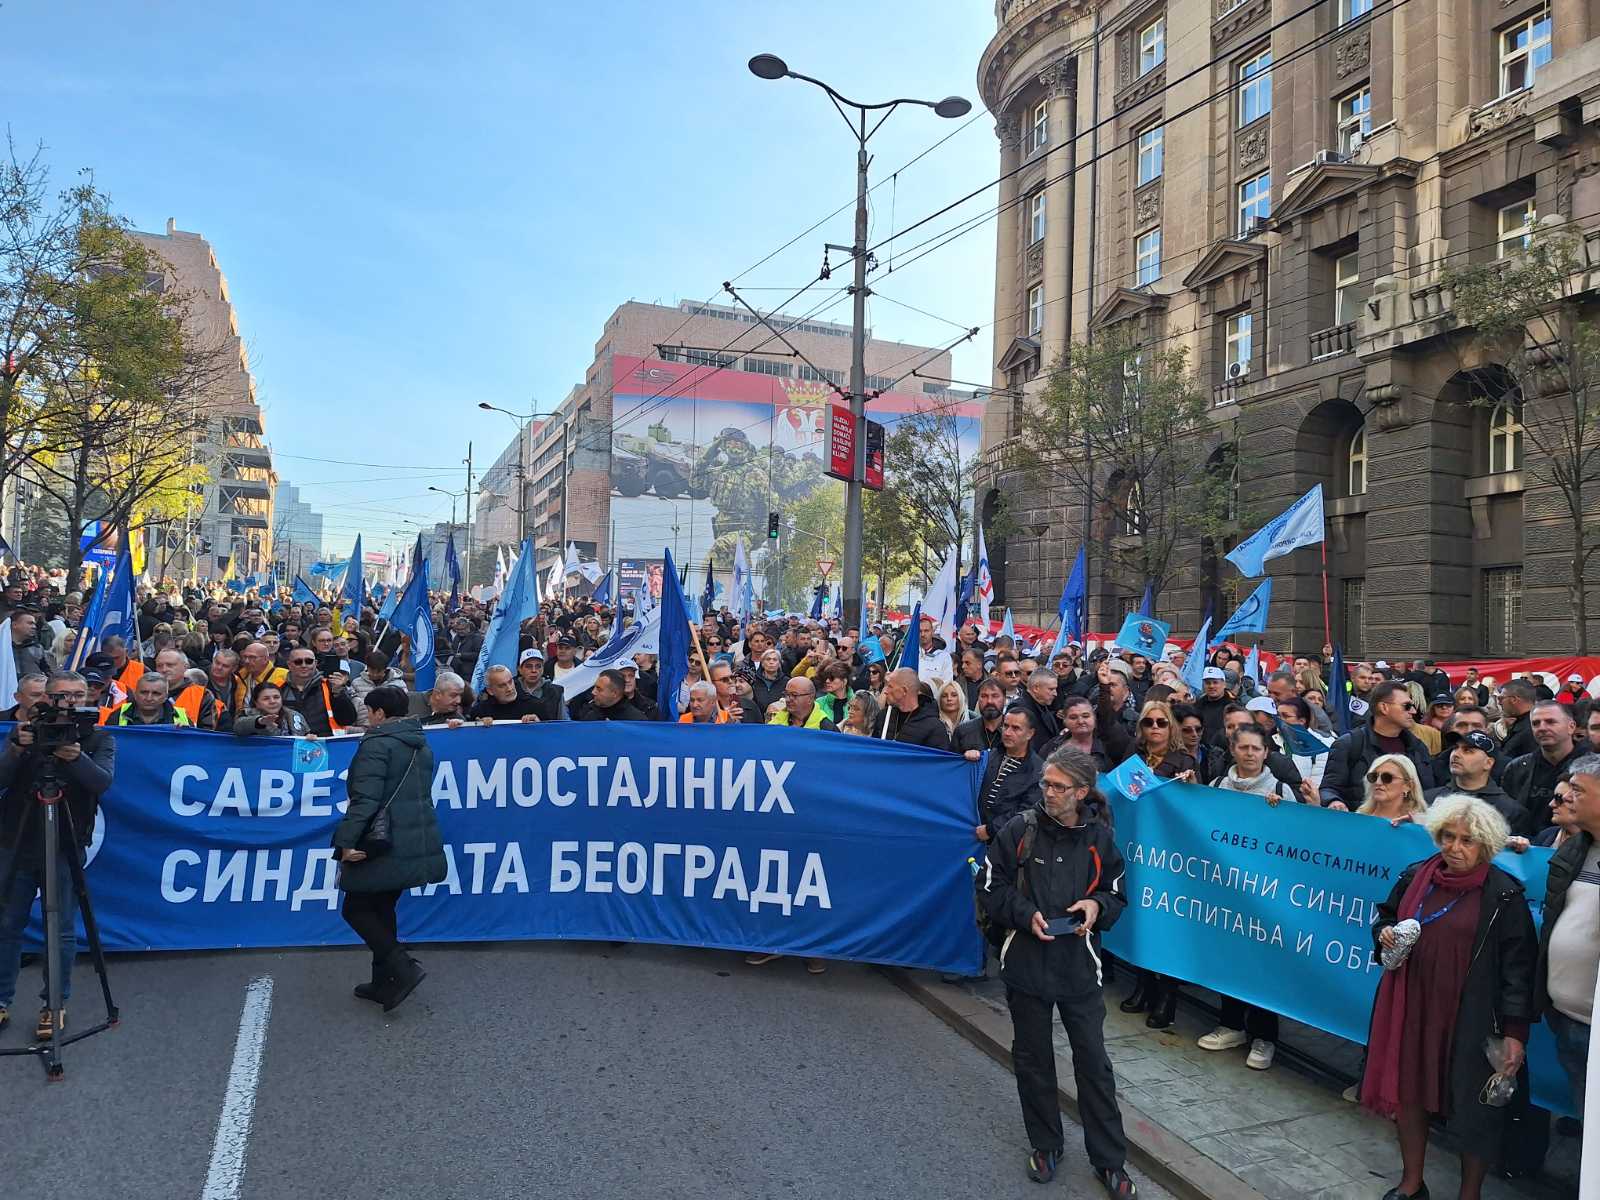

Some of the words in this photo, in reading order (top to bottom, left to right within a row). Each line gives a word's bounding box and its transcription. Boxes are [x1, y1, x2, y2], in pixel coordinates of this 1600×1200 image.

[430, 756, 796, 814] АМОСТАЛНИХ
[160, 841, 530, 912] СИНДАТА
[549, 840, 832, 917] БЕОГРАДА
[1126, 841, 1280, 899] САМОСТАЛНИ
[1210, 829, 1259, 850] САВЕЗ
[1264, 841, 1391, 881] САМОСТАЛНИХ
[1141, 886, 1284, 949] ВАСПИТАЊА
[1296, 930, 1314, 957] И
